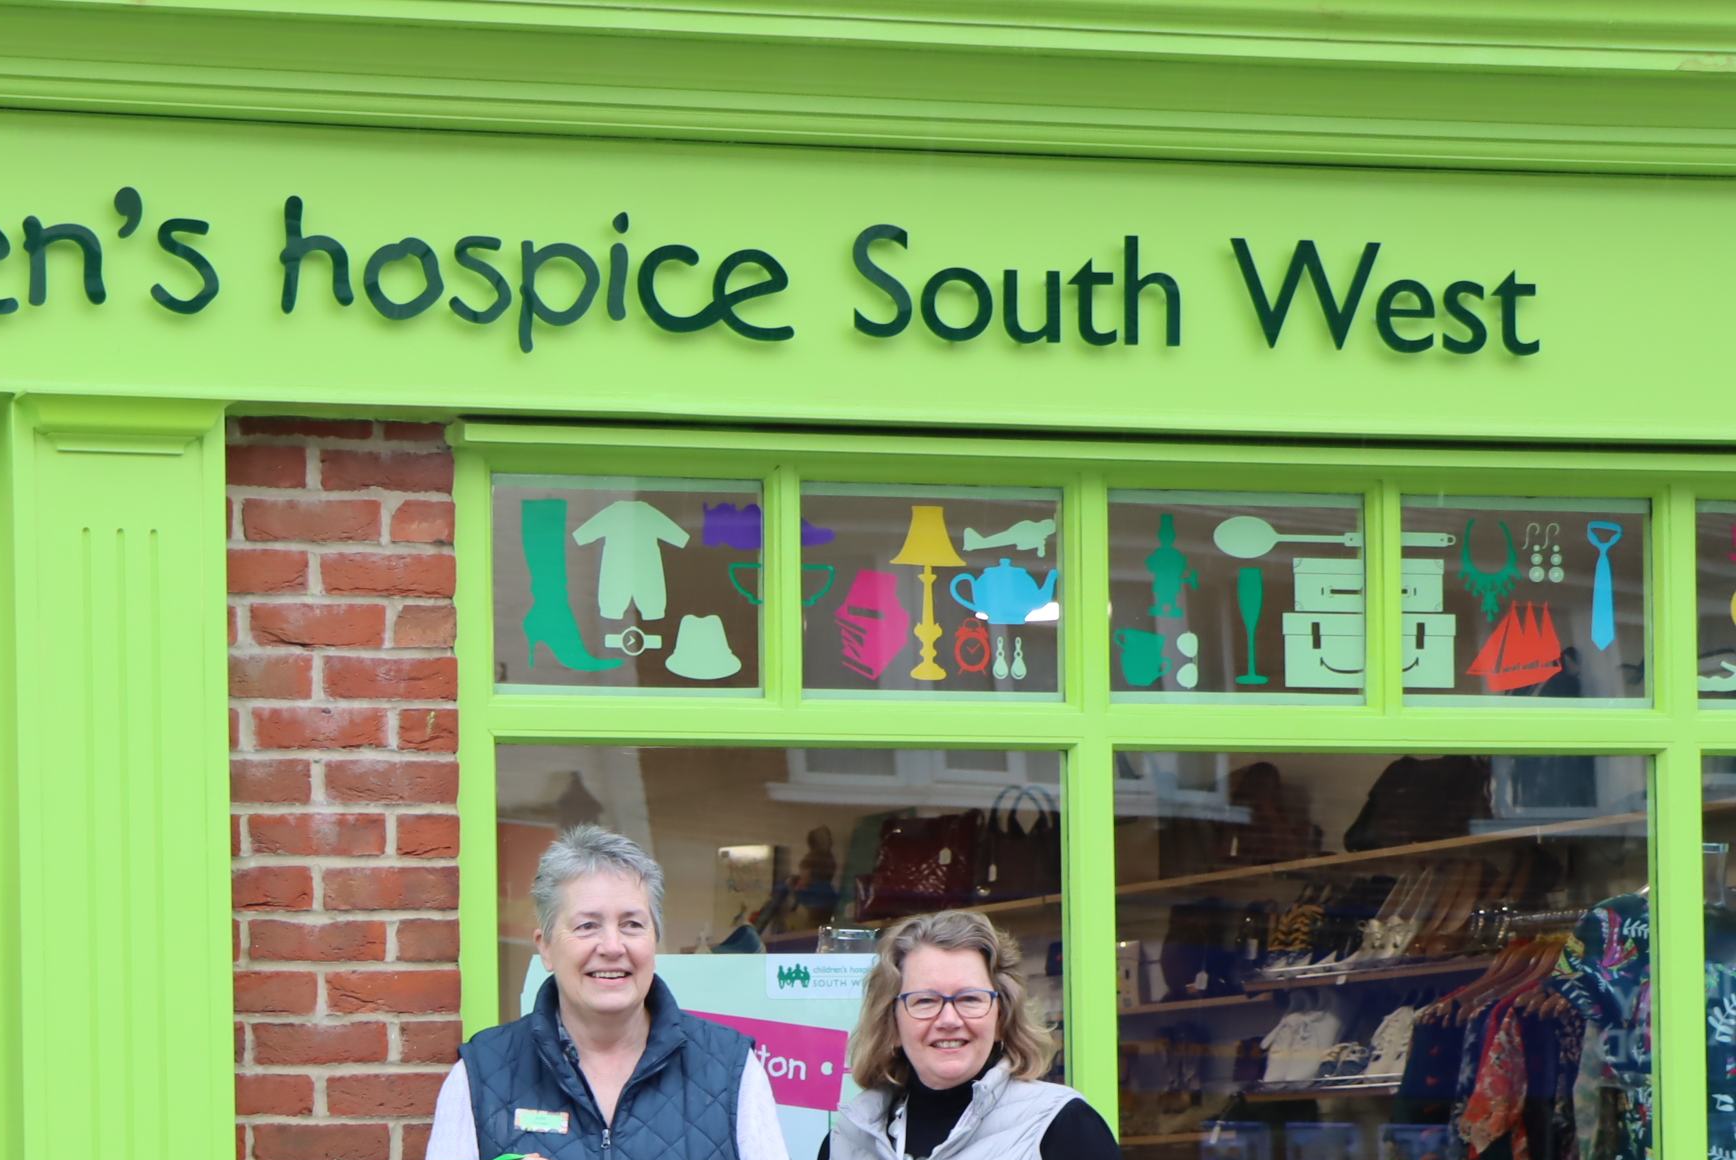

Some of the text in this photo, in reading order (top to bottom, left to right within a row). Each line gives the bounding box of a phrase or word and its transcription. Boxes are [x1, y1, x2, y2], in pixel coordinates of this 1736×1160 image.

[279, 196, 794, 354] hospice
[853, 224, 1181, 346] South
[1229, 237, 1540, 357] West
[755, 1044, 807, 1081] ton
